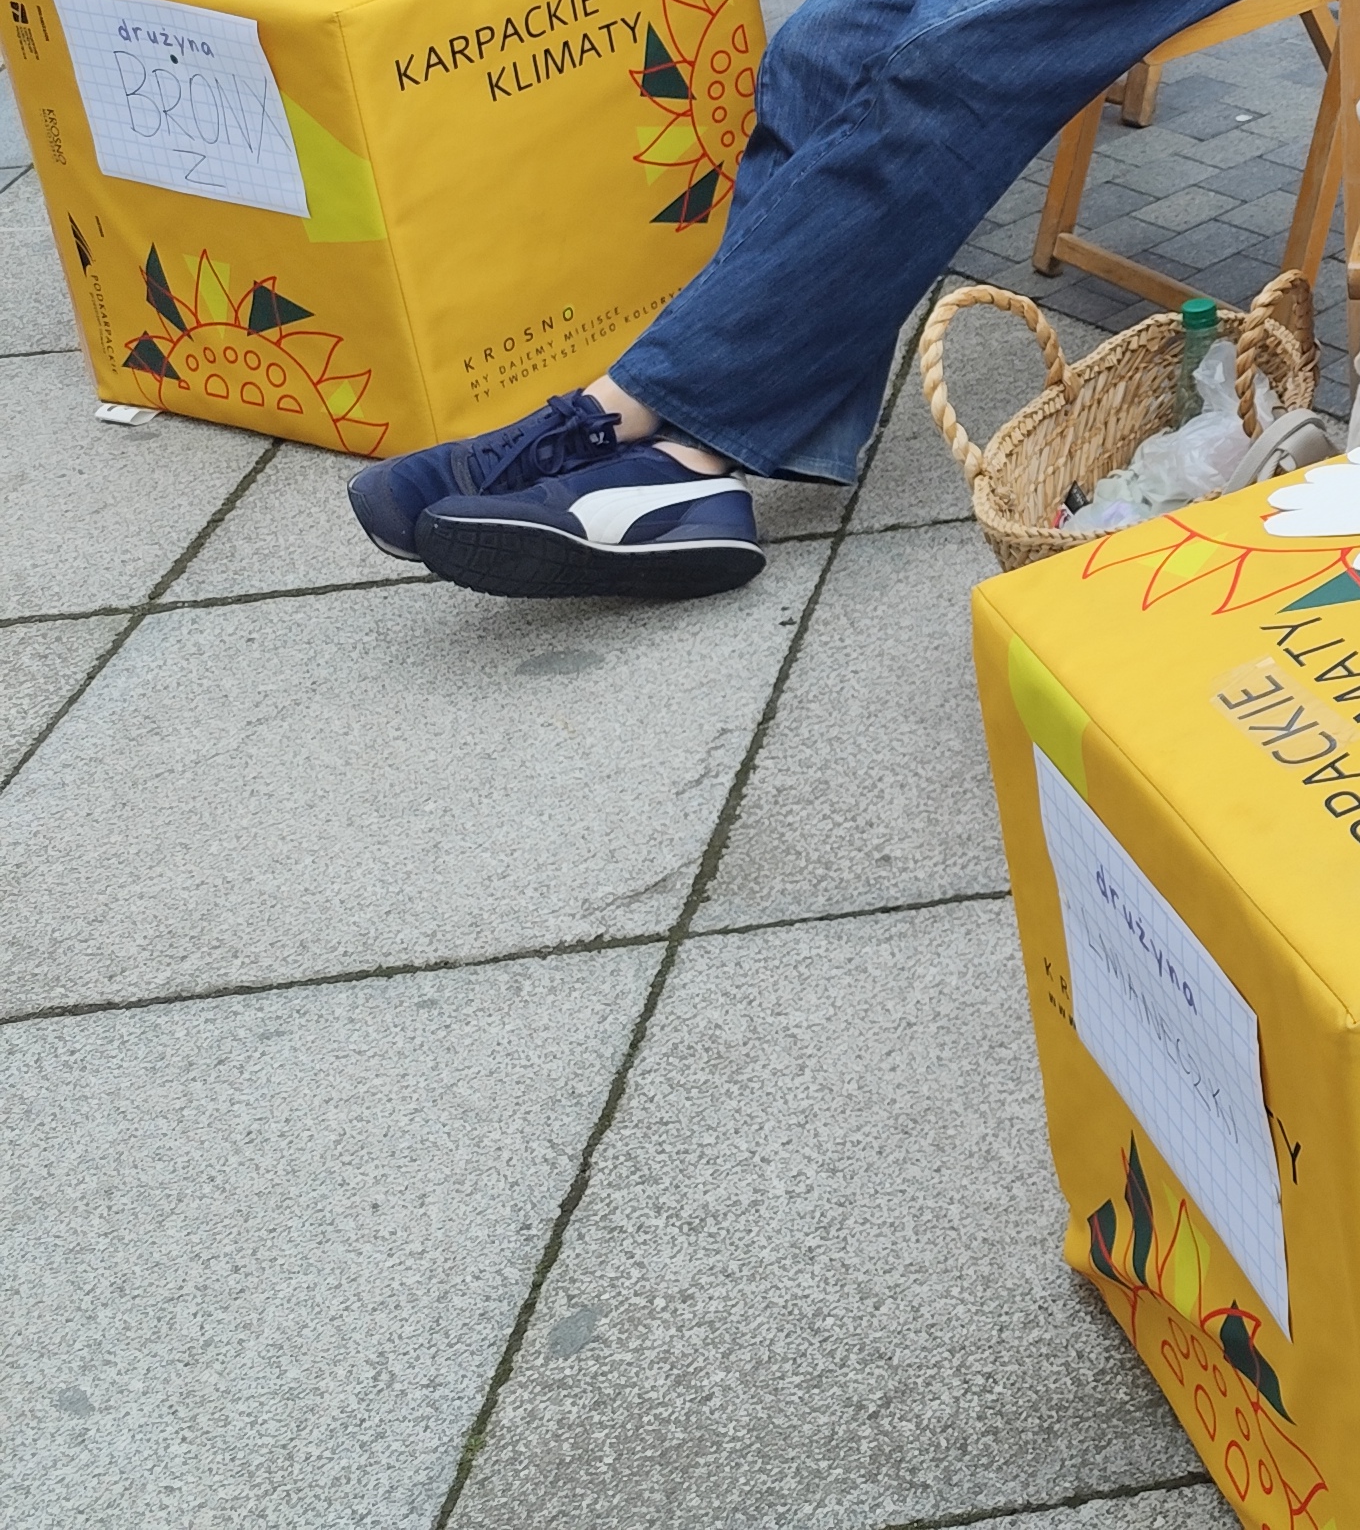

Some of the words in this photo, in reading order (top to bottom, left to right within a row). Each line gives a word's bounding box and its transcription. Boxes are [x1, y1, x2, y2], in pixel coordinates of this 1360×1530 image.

[118, 19, 215, 58] drużyna
[486, 11, 642, 102] KLIMATY
[113, 50, 292, 164] BRONX
[463, 307, 574, 373] KROSNO
[470, 374, 490, 390] MY
[474, 389, 491, 403] TY
[499, 344, 578, 389] TWORZYSZ
[624, 287, 683, 324] KOLORY
[1094, 863, 1199, 1016] drużyna
